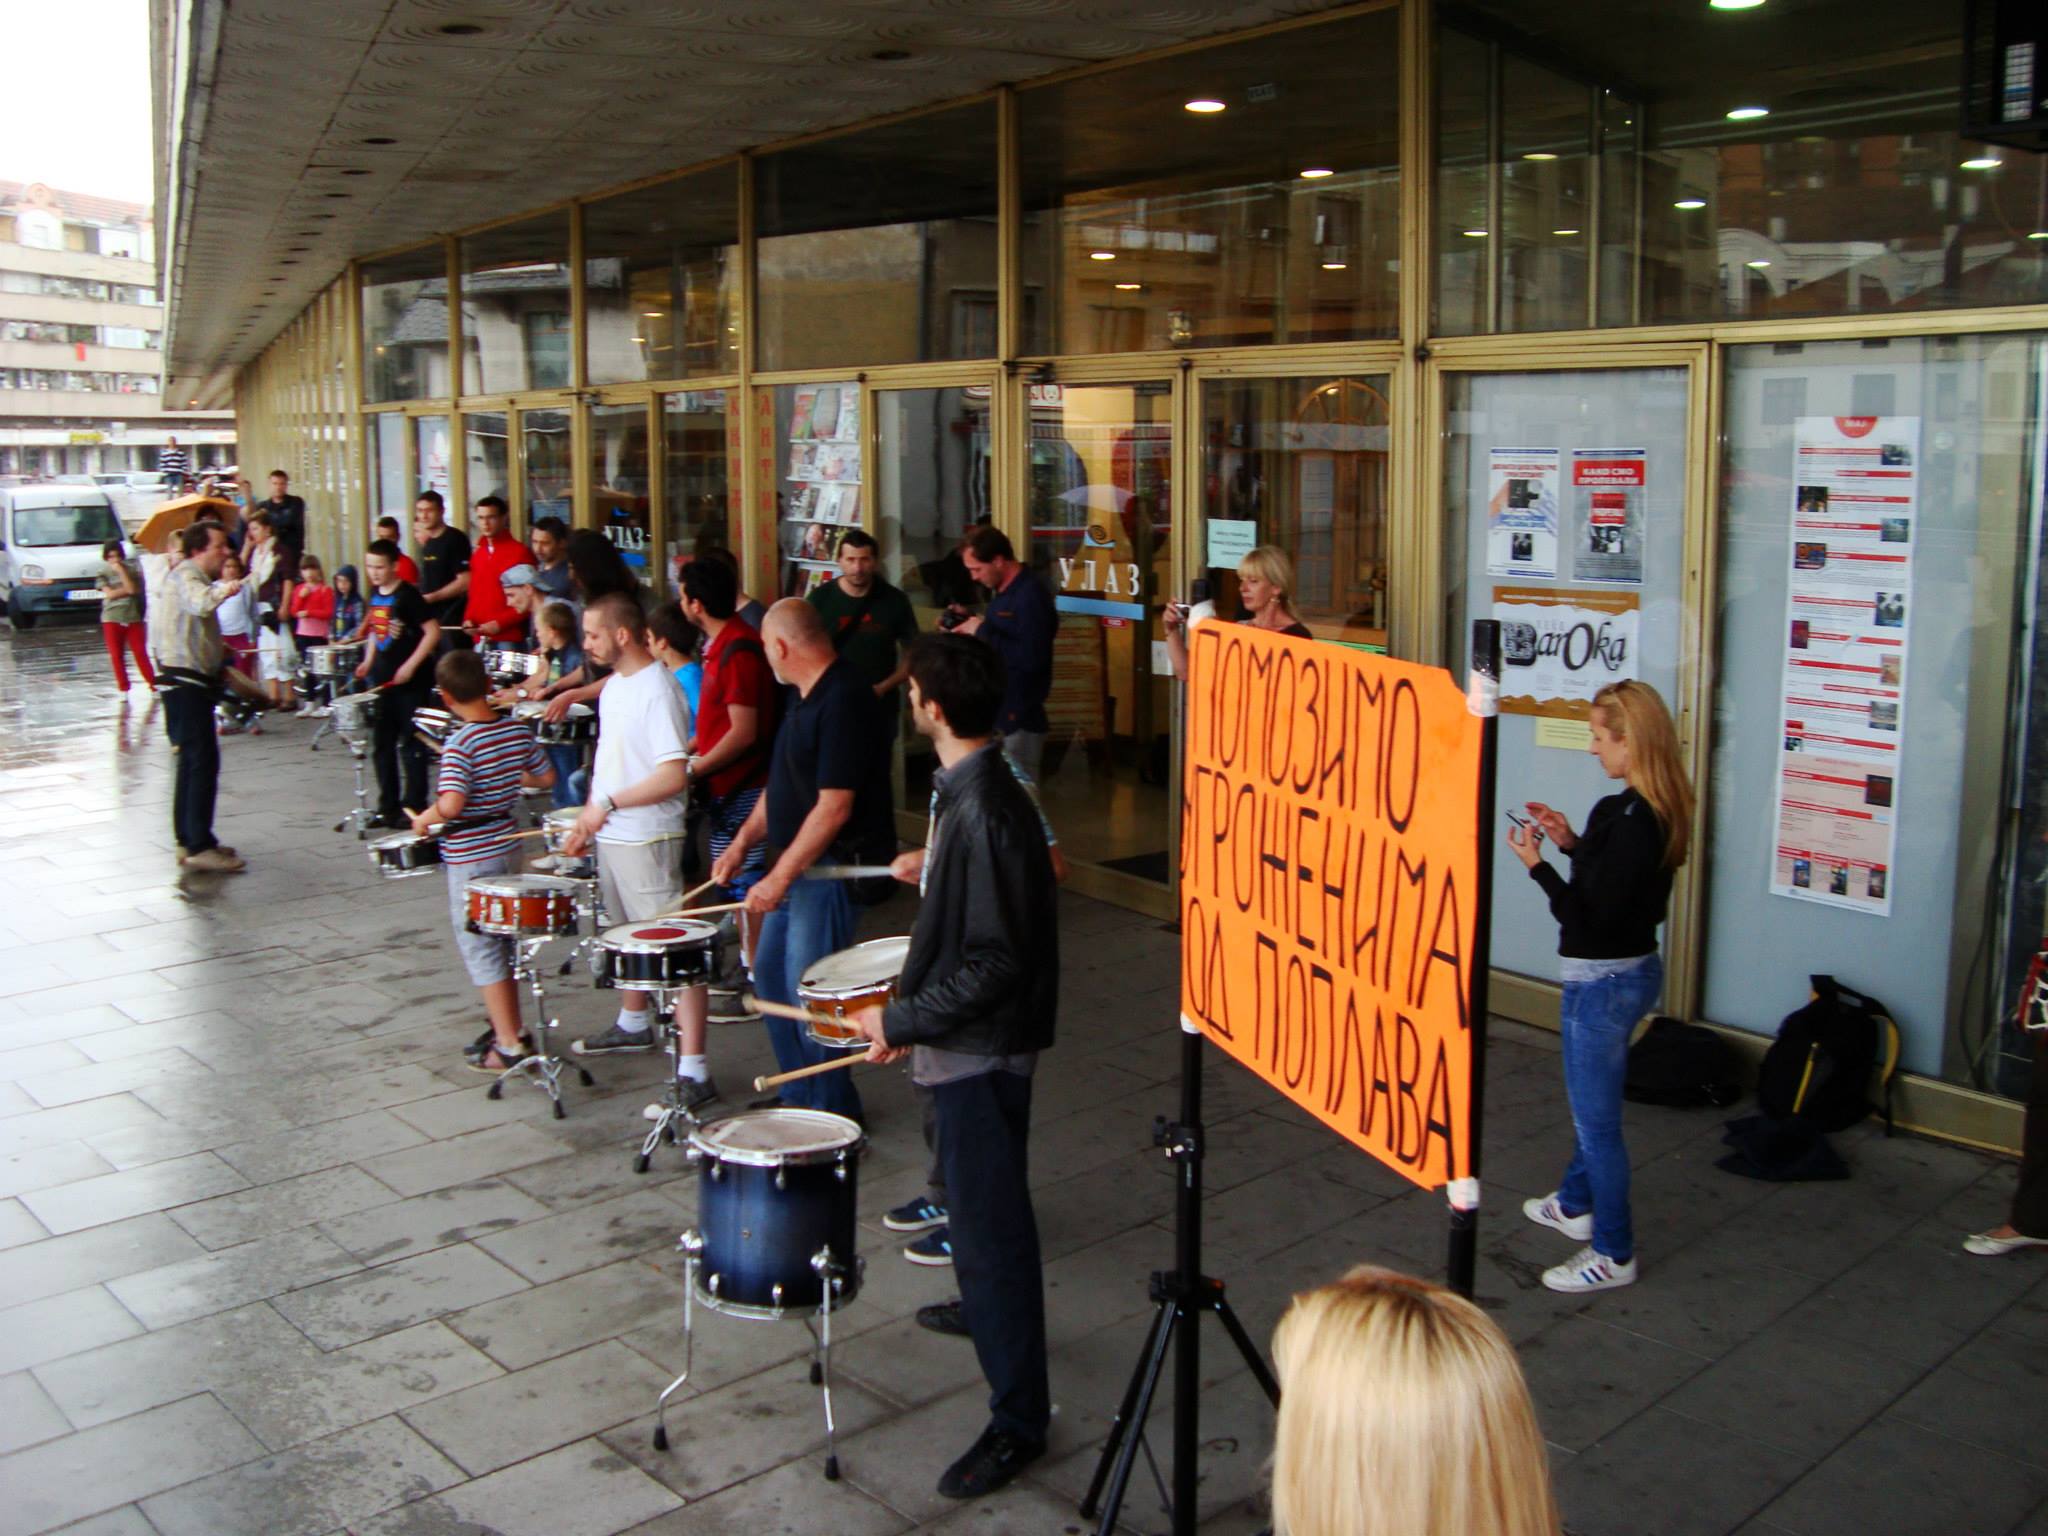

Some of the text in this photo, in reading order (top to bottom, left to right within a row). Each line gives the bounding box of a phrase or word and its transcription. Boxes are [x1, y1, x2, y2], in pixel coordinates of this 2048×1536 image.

[1058, 557, 1140, 596] УЛАЗ
[1503, 620, 1627, 672] BarOka
[1193, 629, 1422, 834] ПОМОЗИМО
[1186, 896, 1456, 1180] ОД ПОПЛАВА
